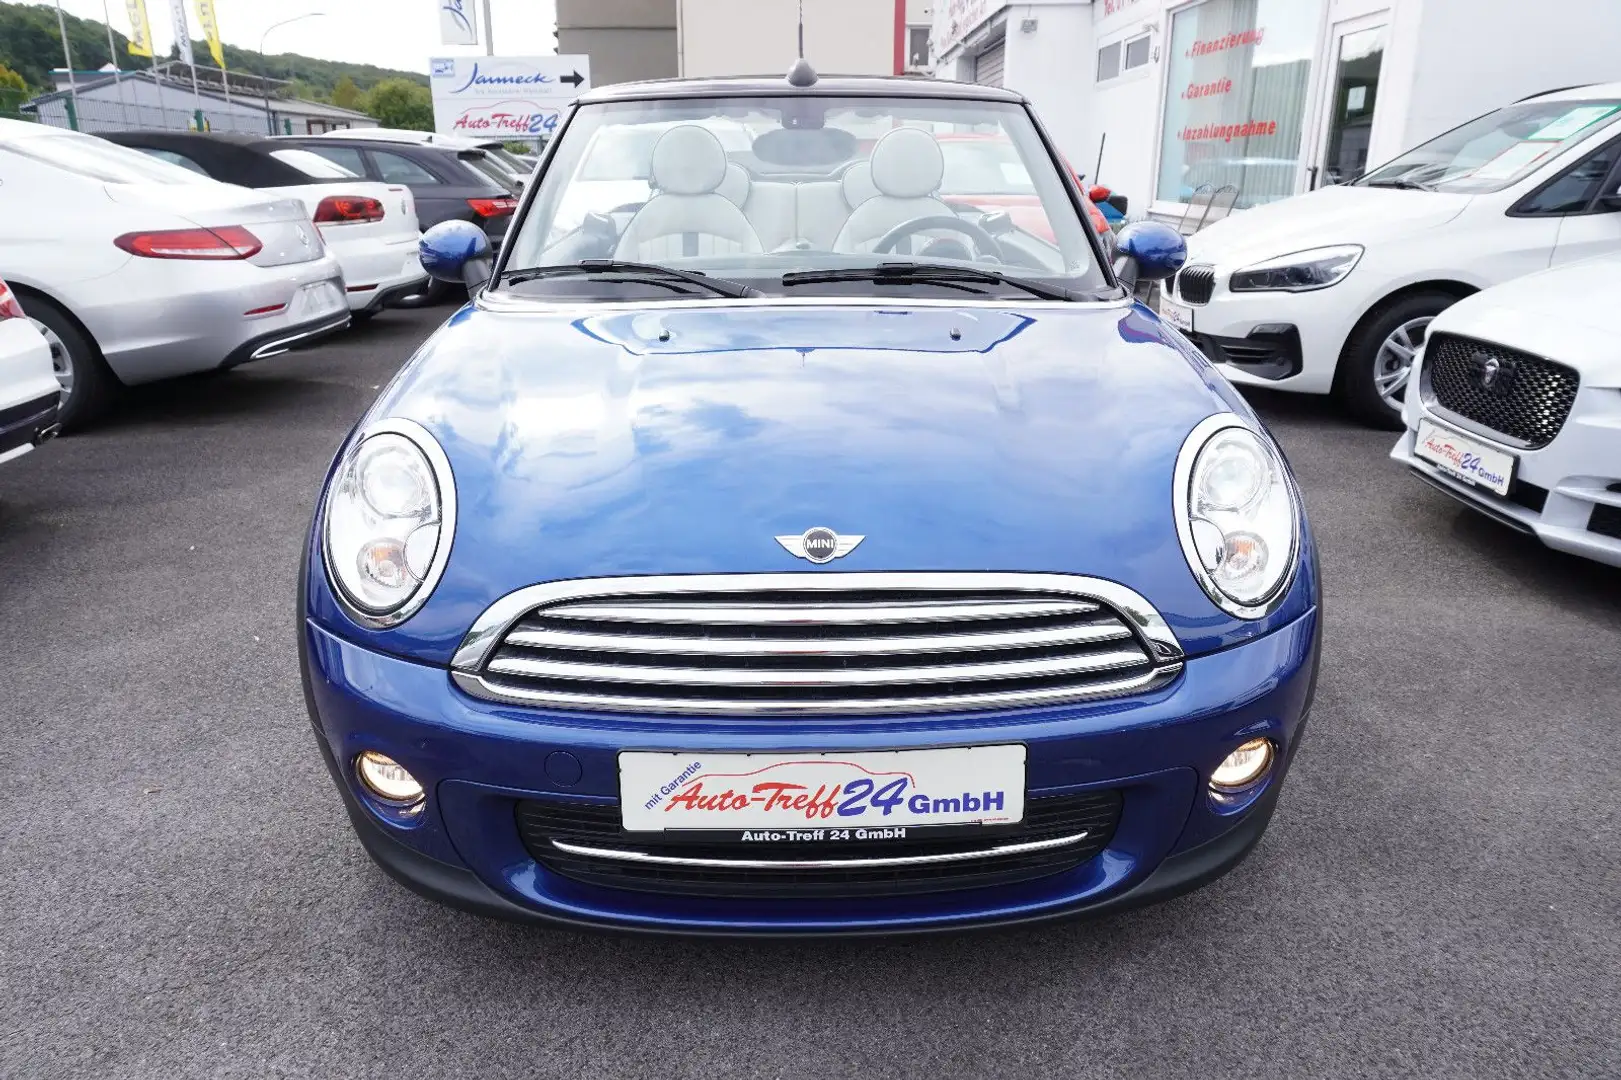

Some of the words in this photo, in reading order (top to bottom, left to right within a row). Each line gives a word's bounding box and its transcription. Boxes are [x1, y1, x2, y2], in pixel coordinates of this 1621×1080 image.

[1191, 27, 1264, 58] Finanzierung
[1186, 77, 1233, 100] Garantie
[1183, 119, 1277, 143] Inzahlungnahme
[1478, 467, 1505, 487] GmbH
[806, 538, 834, 549] MINI
[644, 792, 663, 811] mit
[660, 760, 703, 797] Garantie
[907, 791, 1005, 815] GmbH
[740, 829, 826, 842] Auto-Treff
[829, 829, 851, 841] 24
[854, 827, 907, 840] GmbH
